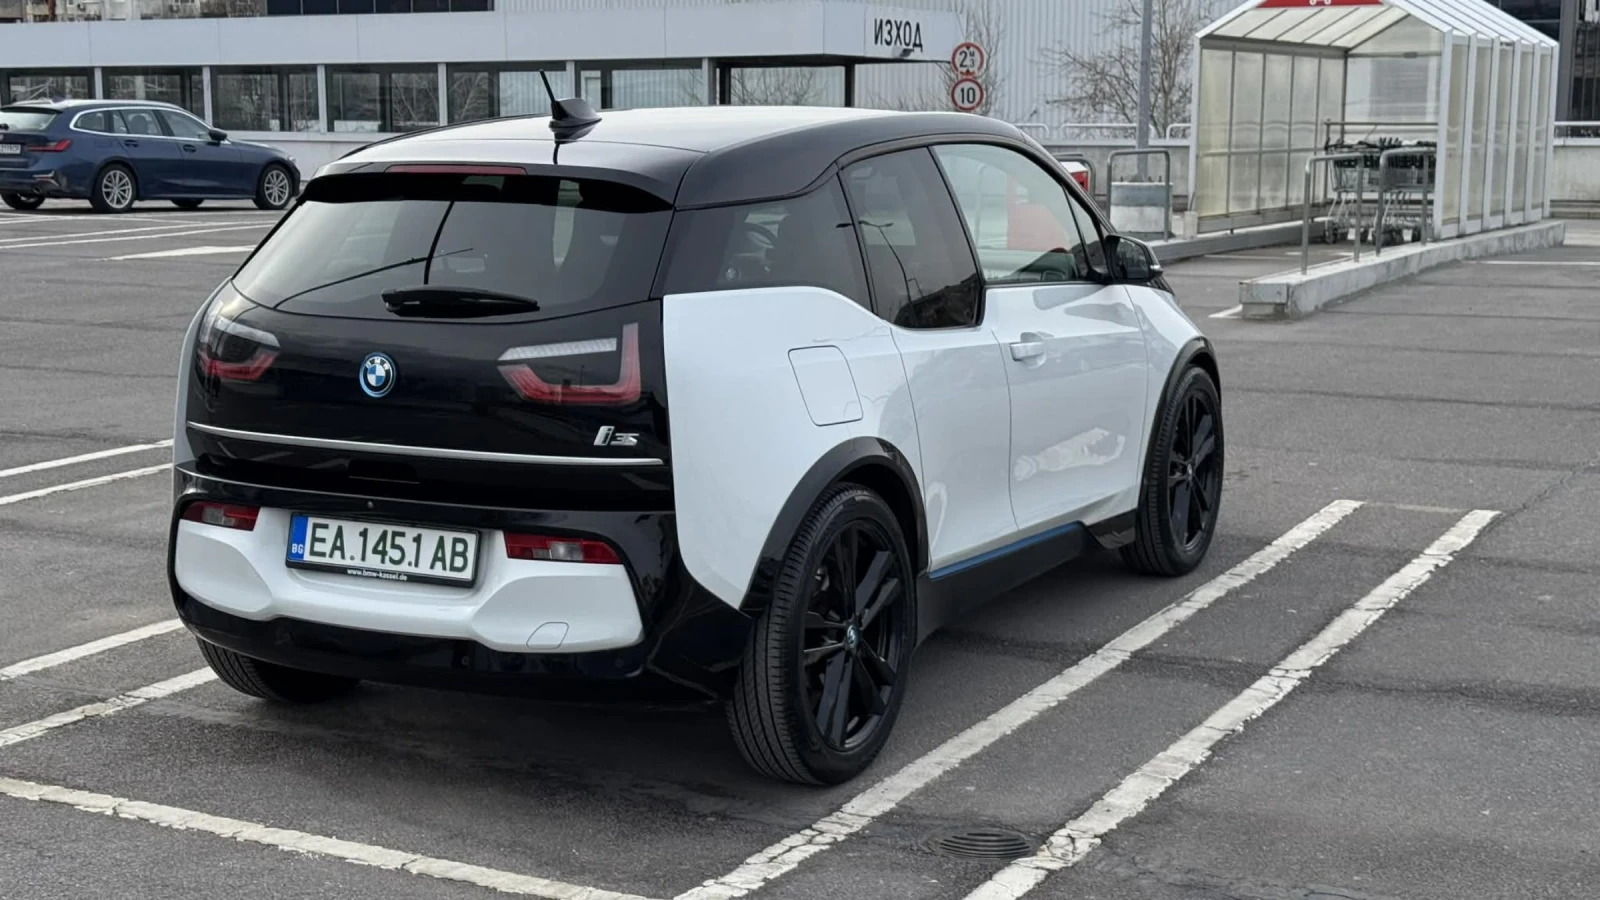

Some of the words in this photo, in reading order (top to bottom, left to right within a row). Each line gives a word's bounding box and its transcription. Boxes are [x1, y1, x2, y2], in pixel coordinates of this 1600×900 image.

[874, 18, 923, 52] ИЗХОД
[960, 87, 976, 104] 10
[291, 543, 304, 554] BG
[430, 535, 468, 573] AB
[347, 568, 407, 581] www.bmw-kassel.de
